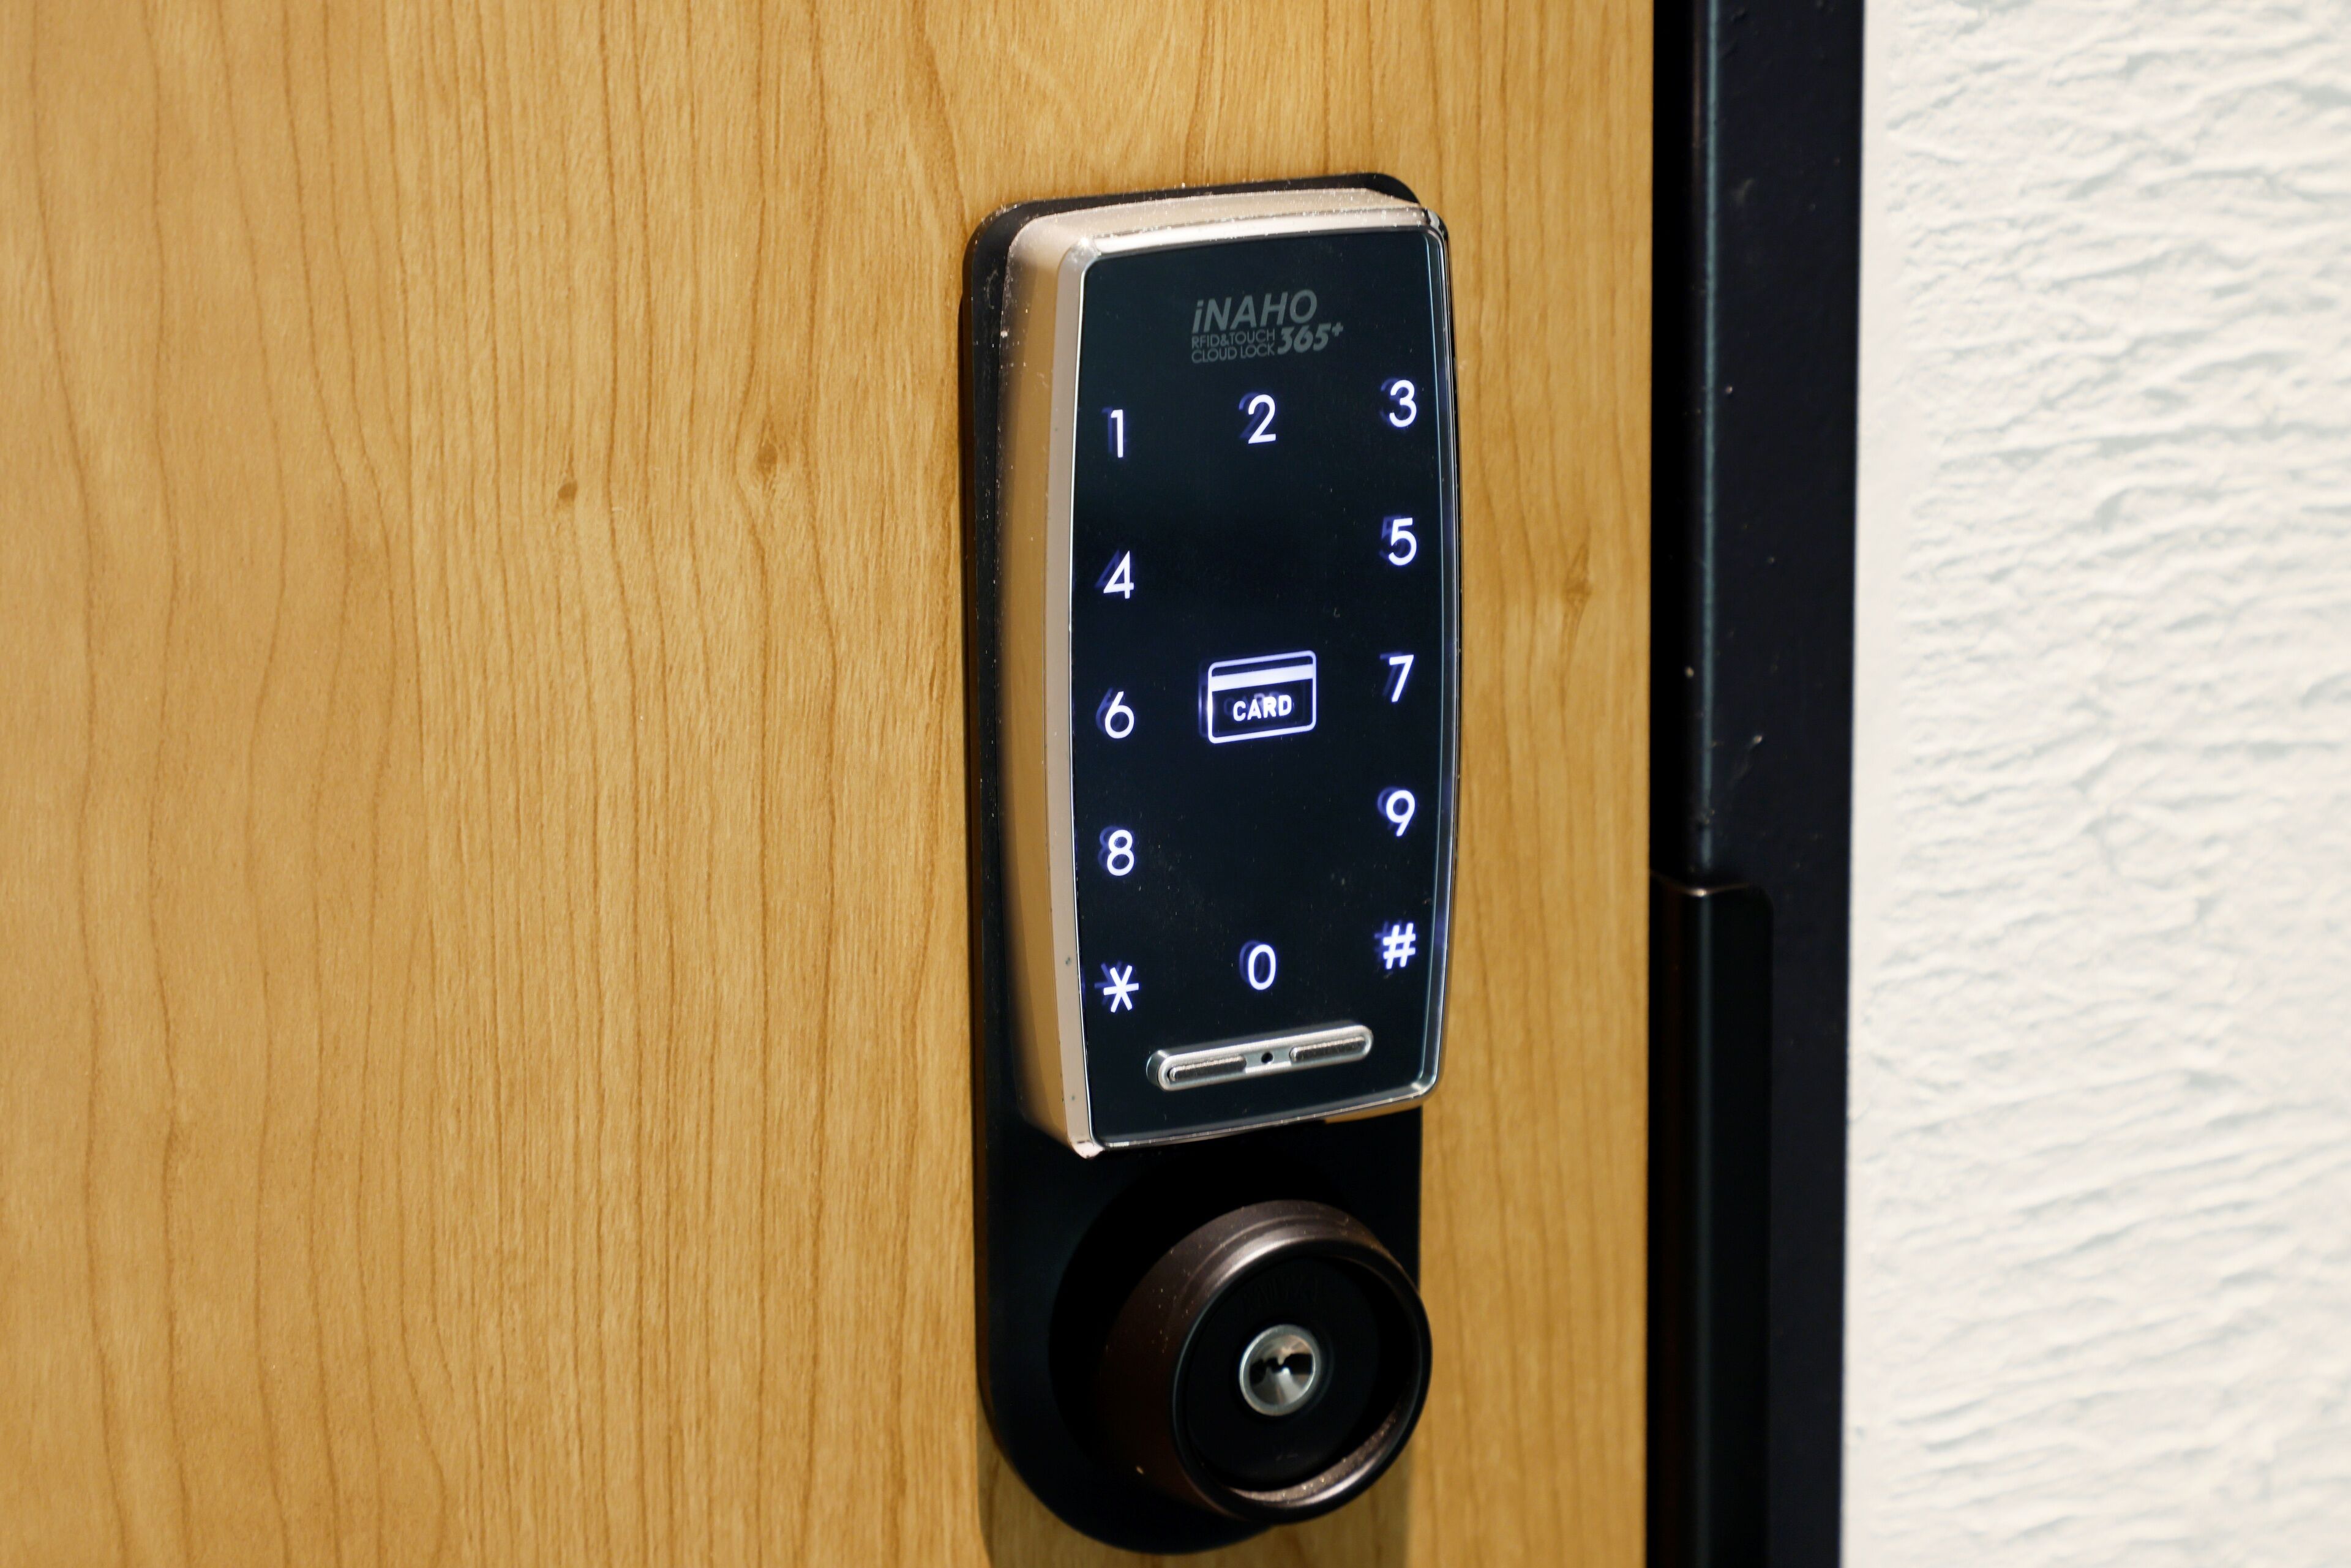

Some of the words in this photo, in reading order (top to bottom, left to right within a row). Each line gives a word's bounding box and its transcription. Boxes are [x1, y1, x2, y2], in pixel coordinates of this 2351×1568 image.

[1191, 328, 1275, 349] RFID&TOUCH
[1191, 346, 1237, 364] CLOUD
[1240, 342, 1275, 359] LOCK
[1109, 409, 1124, 458] 1
[1247, 394, 1277, 445] 2
[1389, 379, 1417, 428] 3
[1103, 550, 1134, 599] 4
[1387, 517, 1417, 566] 5
[1104, 691, 1134, 739] 6
[1388, 654, 1414, 702] 7
[1232, 694, 1292, 722] CARD
[1106, 829, 1134, 876] 8
[1385, 790, 1415, 837] 9
[1247, 943, 1277, 991] 0
[1382, 922, 1416, 970] #
